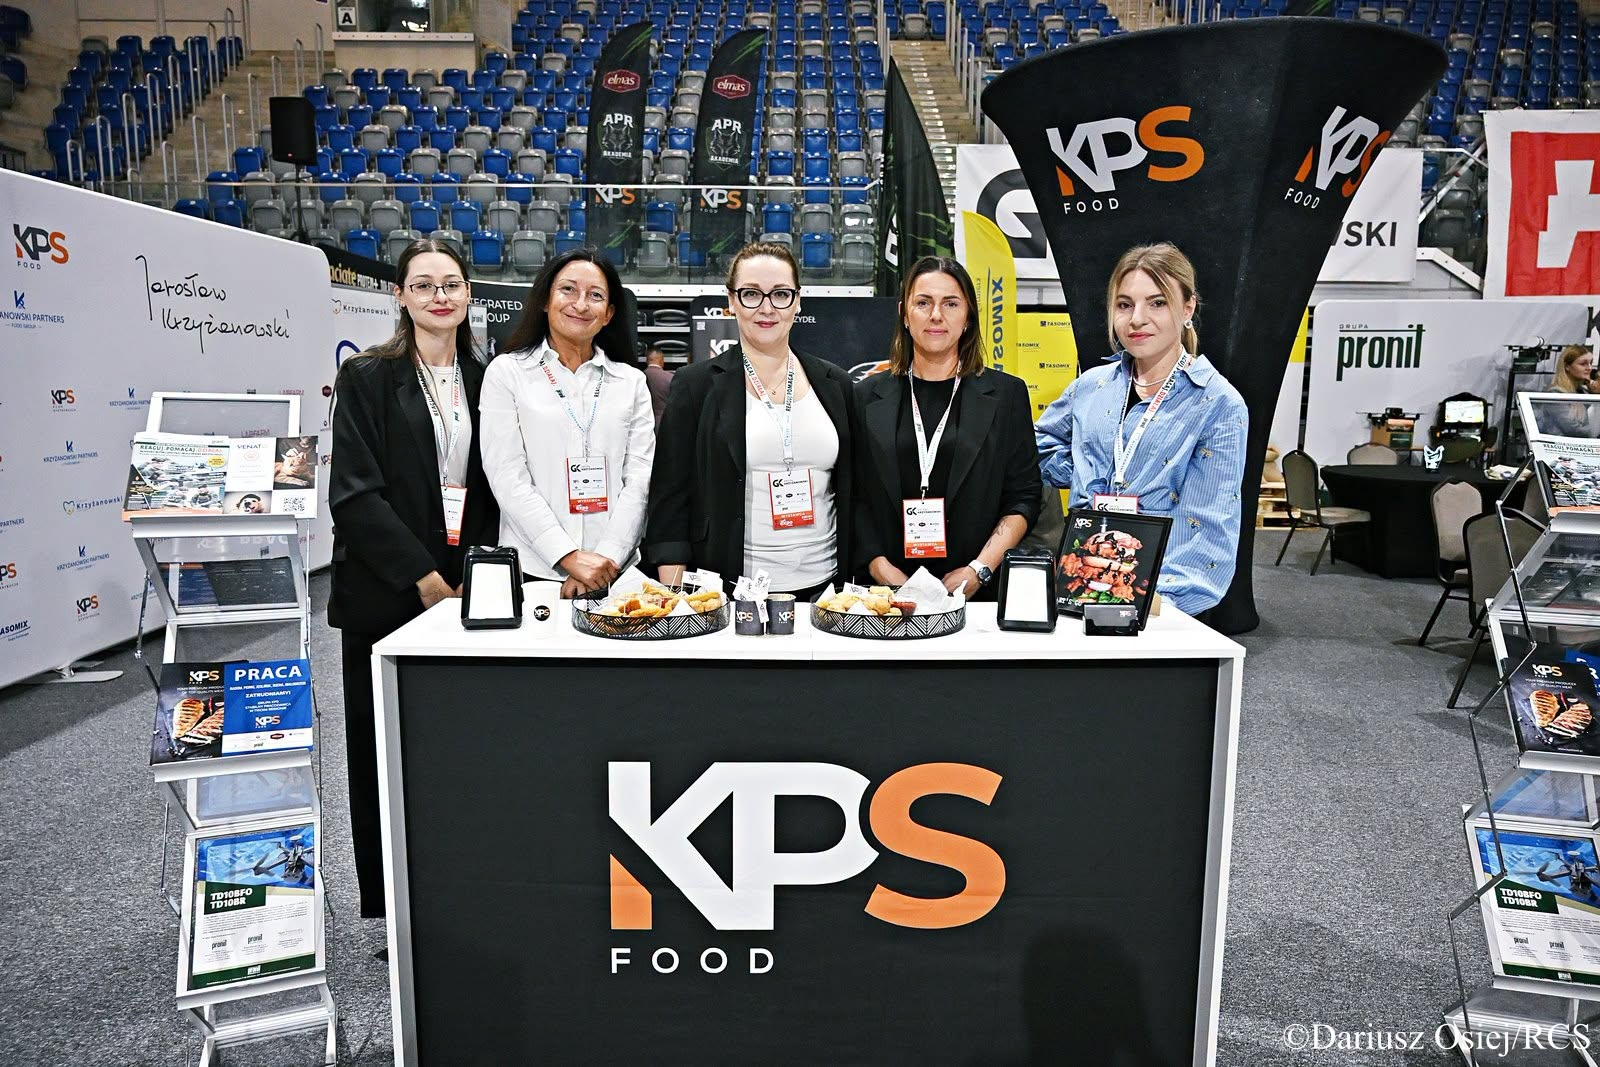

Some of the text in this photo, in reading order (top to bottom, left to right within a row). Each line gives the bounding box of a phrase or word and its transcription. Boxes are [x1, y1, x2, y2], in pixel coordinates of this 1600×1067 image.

[342, 12, 353, 25] A
[607, 73, 636, 86] elmas
[716, 79, 746, 93] elmas
[602, 113, 633, 129] APR
[711, 118, 742, 135] APR
[603, 150, 632, 159] AKADEMIA
[1046, 105, 1205, 197] KPS
[1294, 105, 1391, 198] KPS
[710, 155, 740, 165] AKADEMIA
[700, 188, 742, 210] KPS
[1284, 188, 1321, 209] FOOD
[1063, 197, 1119, 215] FOOD
[13, 224, 69, 264] KPS
[17, 260, 42, 270] FOOD
[343, 303, 390, 316] Krzyżanowski
[32, 314, 65, 324] PARTNERS
[1336, 323, 1426, 382] pronit
[51, 389, 76, 405] KPS
[76, 496, 123, 510] Krzyżanowski
[1074, 517, 1093, 528] KPS
[76, 595, 99, 614] KPS
[534, 608, 550, 618] KPS
[736, 610, 754, 622] KPS
[189, 670, 220, 682] KPS
[234, 665, 302, 682] PRACA
[1531, 663, 1563, 677] KPS
[255, 716, 281, 727] KPS
[607, 761, 1007, 931] KPS
[210, 887, 253, 901] TD10BFO
[1500, 887, 1542, 900] TD10BFO
[210, 896, 246, 909] TD10BR
[1501, 896, 1538, 908] TD10BR
[247, 933, 263, 945] pronit
[611, 946, 775, 975] FOOD
